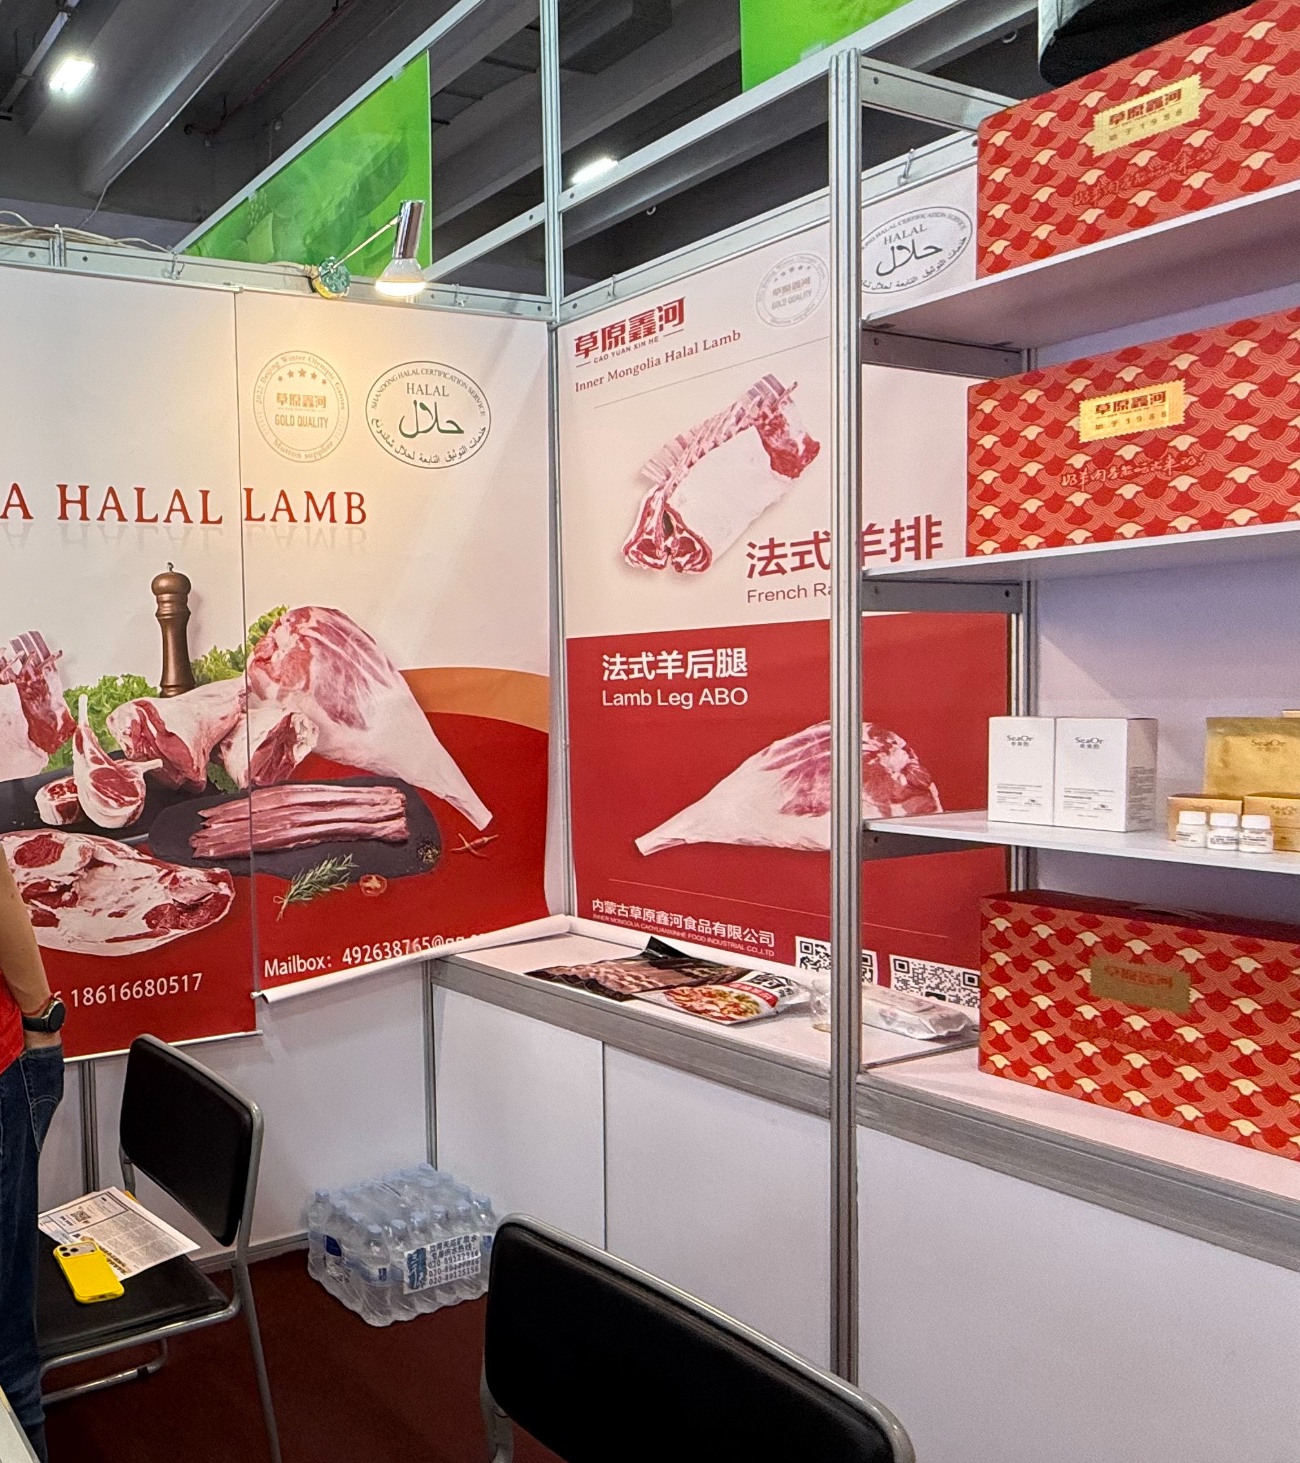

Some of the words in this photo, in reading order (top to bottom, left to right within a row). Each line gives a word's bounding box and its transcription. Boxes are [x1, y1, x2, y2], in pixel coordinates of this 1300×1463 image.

[884, 224, 928, 245] HALAL
[876, 239, 943, 276] حلال
[573, 296, 686, 359] 草原鑫河
[574, 376, 604, 393] Inner
[607, 356, 662, 383] Mongolia
[664, 342, 699, 364] Halal
[702, 330, 742, 351] Lamb
[593, 354, 609, 364] CAO
[611, 346, 631, 359] YUAN
[633, 340, 647, 351] XIN
[648, 336, 659, 346] HE
[260, 361, 281, 384] Beijing
[308, 357, 336, 381] Olympic
[371, 374, 399, 409] SHANDONG
[397, 367, 421, 380] HALAL
[420, 367, 469, 390] CERTIFICATION
[467, 386, 486, 417] SERVICE
[406, 382, 450, 397] HALAL
[274, 414, 295, 427] GOLD
[297, 416, 329, 428] QUALITY
[398, 400, 465, 439] حلال
[273, 439, 302, 459] Mutton
[56, 483, 222, 526] HALAL
[243, 487, 367, 525] LAMB
[747, 584, 808, 604] French
[602, 647, 749, 681] 法式羊后腿
[602, 688, 653, 706] Lamb
[657, 688, 694, 710] Leg
[699, 687, 749, 706] ABO
[592, 898, 776, 948] 内蒙古草原鑫河食品有限公司
[342, 934, 484, 965] 492638765@
[687, 933, 707, 943] FOOD
[707, 936, 745, 951] INDUSTRIAL
[71, 972, 203, 1008] 18616680517
